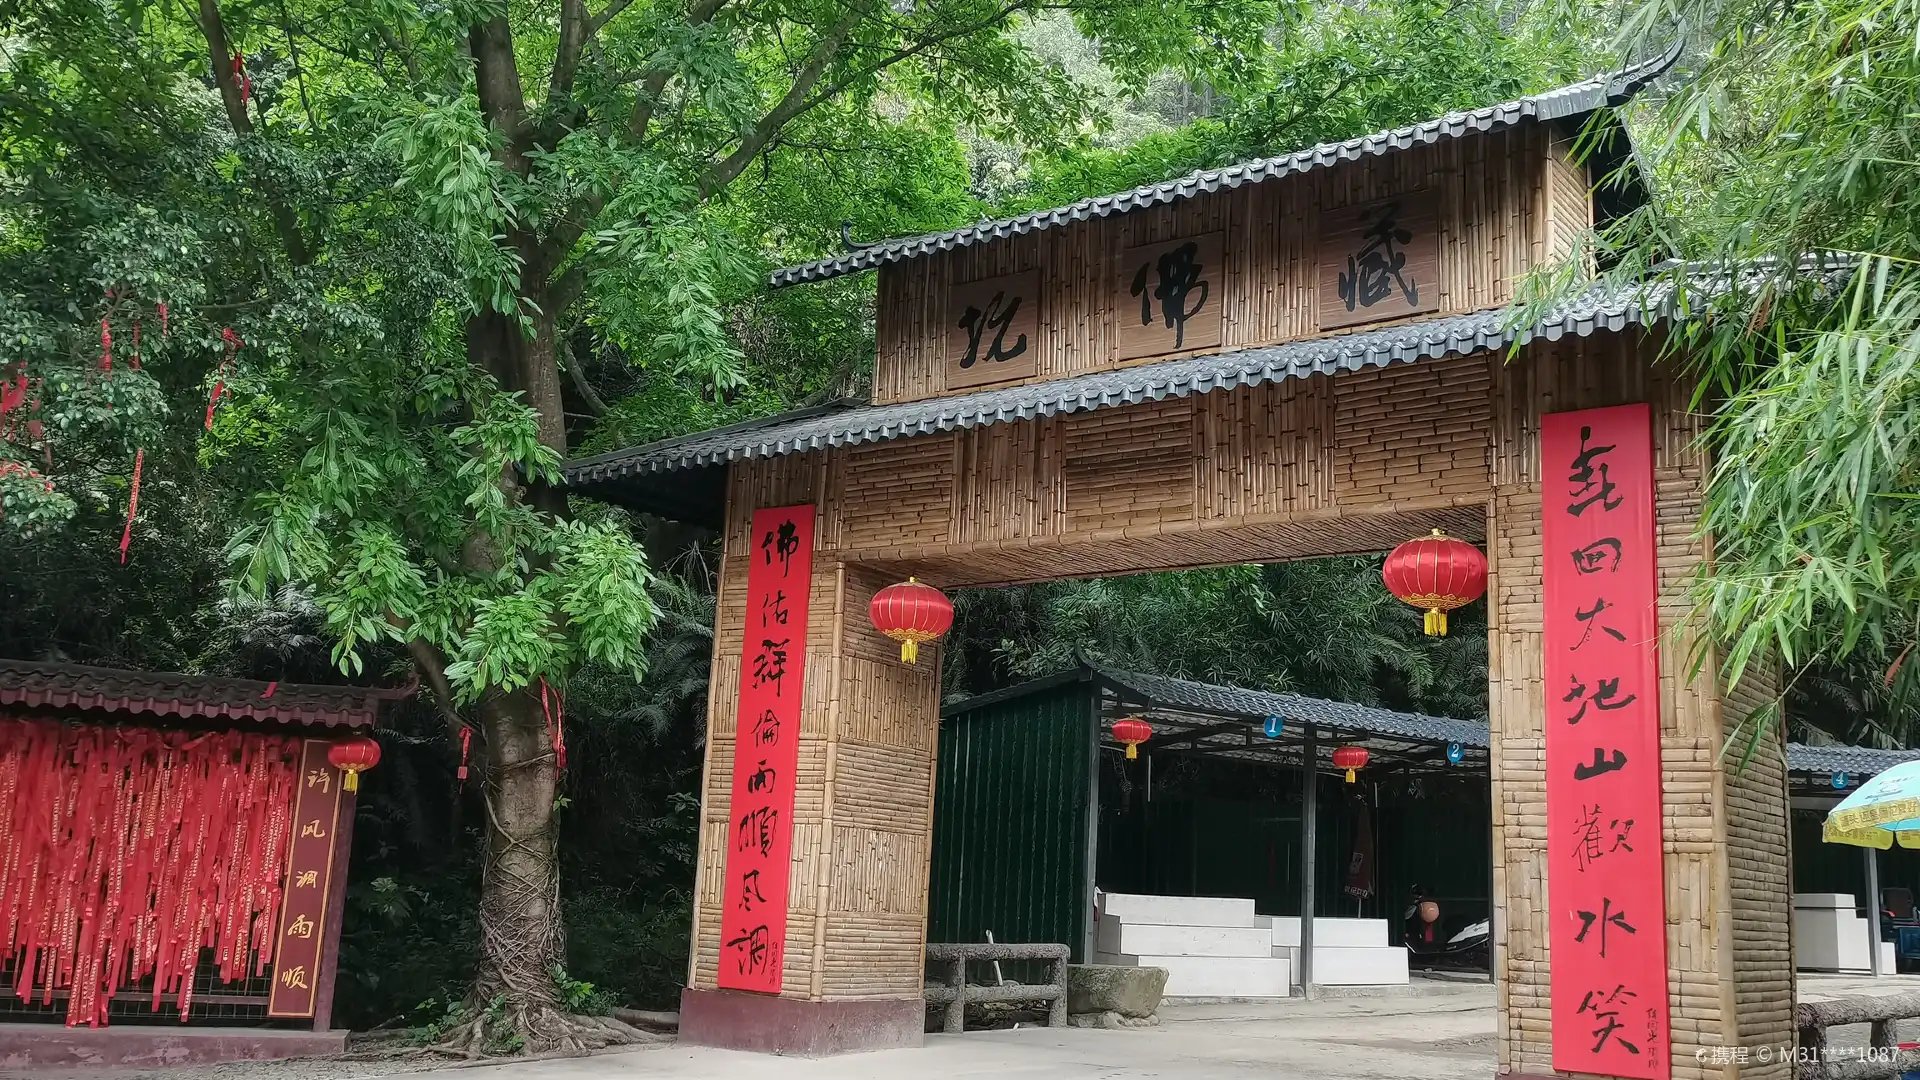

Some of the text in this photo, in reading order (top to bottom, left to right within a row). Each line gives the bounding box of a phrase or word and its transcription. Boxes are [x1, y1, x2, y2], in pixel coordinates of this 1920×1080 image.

[1268, 718, 1277, 733] 1
[1451, 743, 1459, 758] 2
[1835, 772, 1844, 785] 4
